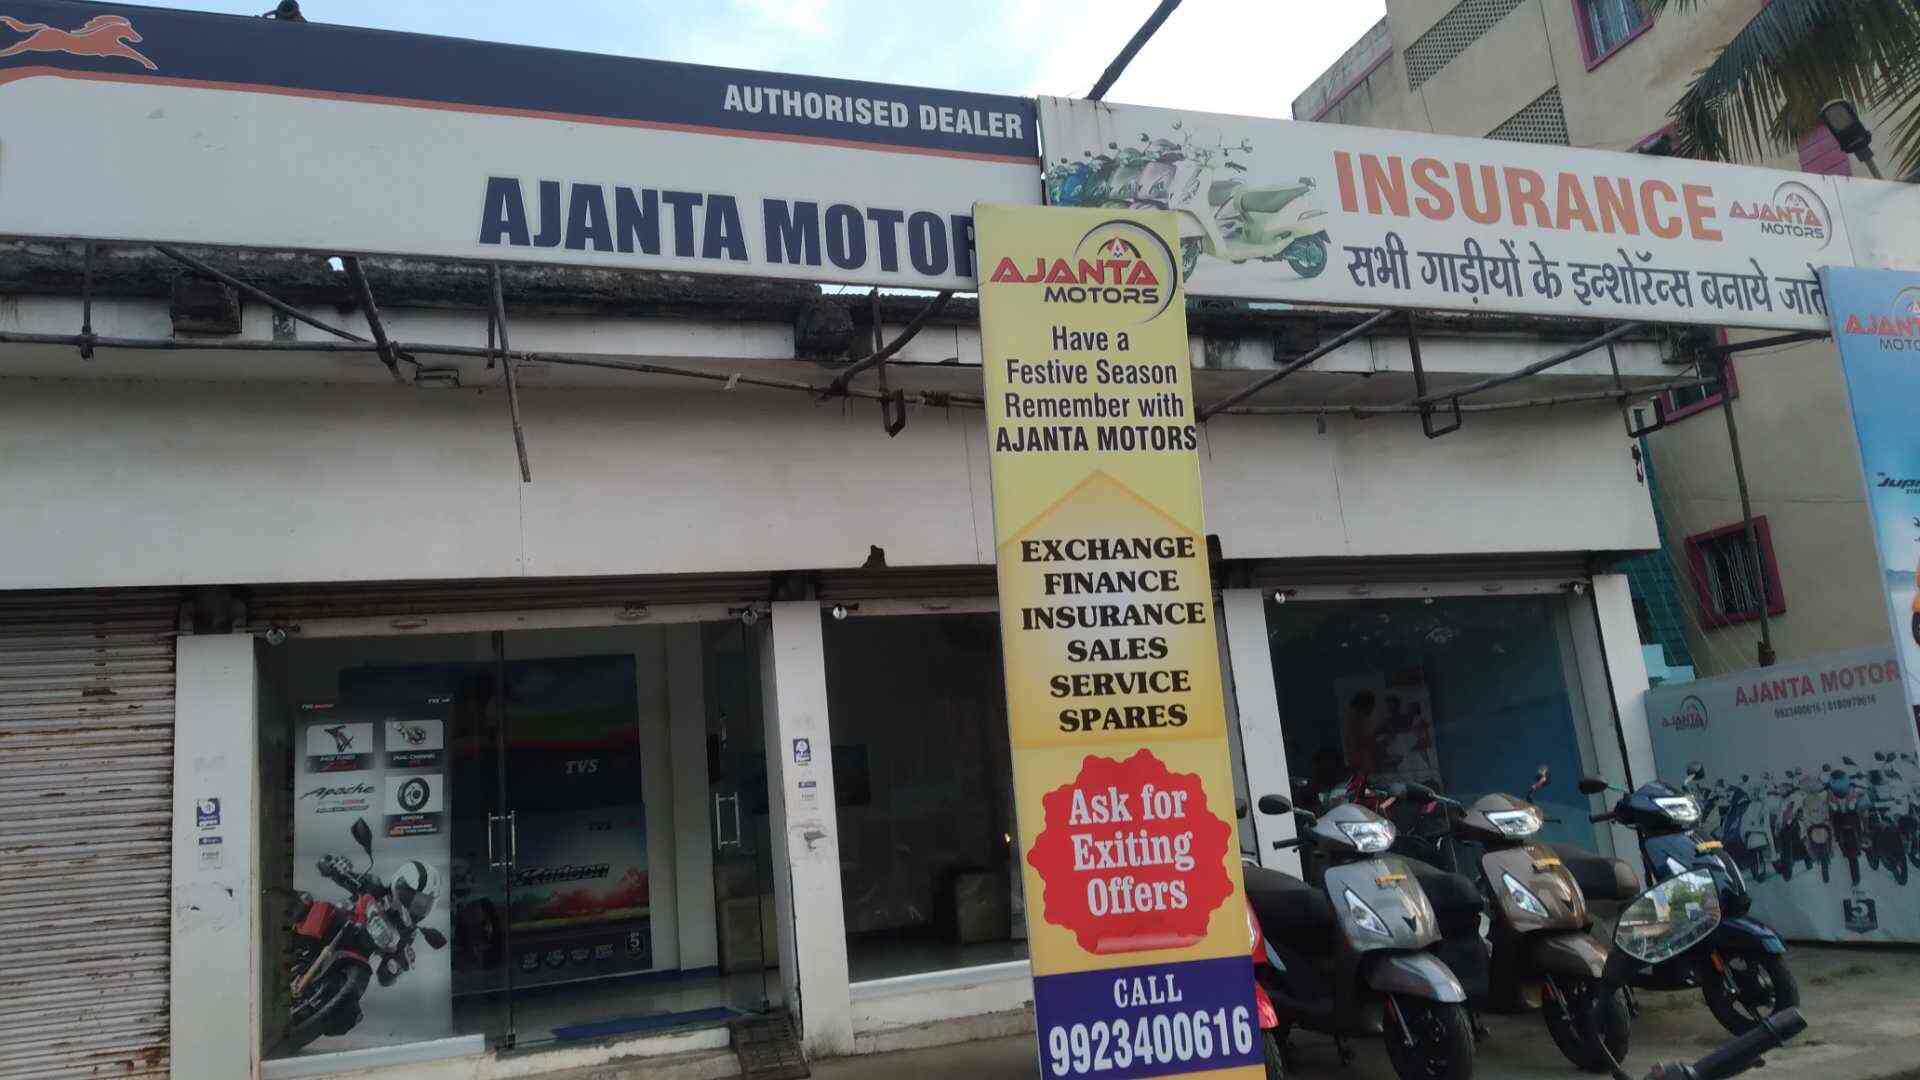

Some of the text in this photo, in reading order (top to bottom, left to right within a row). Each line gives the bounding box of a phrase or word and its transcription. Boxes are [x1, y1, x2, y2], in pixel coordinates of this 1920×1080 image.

[724, 84, 1023, 139] AUTHORISED DEALER
[1334, 150, 1723, 241] INSURANCE
[479, 176, 748, 261] AJANTA
[1729, 200, 1823, 226] AJANTA
[1761, 223, 1824, 239] MOTORS
[990, 256, 1160, 285] AJANTA
[1343, 231, 1411, 289] सभी
[1528, 240, 1562, 299] के
[1044, 286, 1159, 304] MOTORS
[1052, 326, 1129, 351] Have a
[1007, 359, 1178, 384] Festive Season
[1005, 392, 1184, 419] Remember with
[996, 425, 1197, 452] AJANTA MOTORS
[1021, 536, 1196, 562] EXCHANGE
[1044, 570, 1180, 595] FINANCE
[1021, 602, 1206, 630] INSURANCE
[1067, 636, 1169, 662] SALES
[1050, 670, 1191, 698] SERVICE
[1735, 675, 1814, 707] AJANTA
[1059, 704, 1188, 732] SPARES
[565, 759, 600, 775] TVS
[1068, 784, 1188, 826] Ask for
[1070, 829, 1195, 872] Exiting
[1087, 876, 1188, 917] Offers
[1113, 973, 1183, 1008] CALL
[1049, 1006, 1252, 1077] 9923400616
